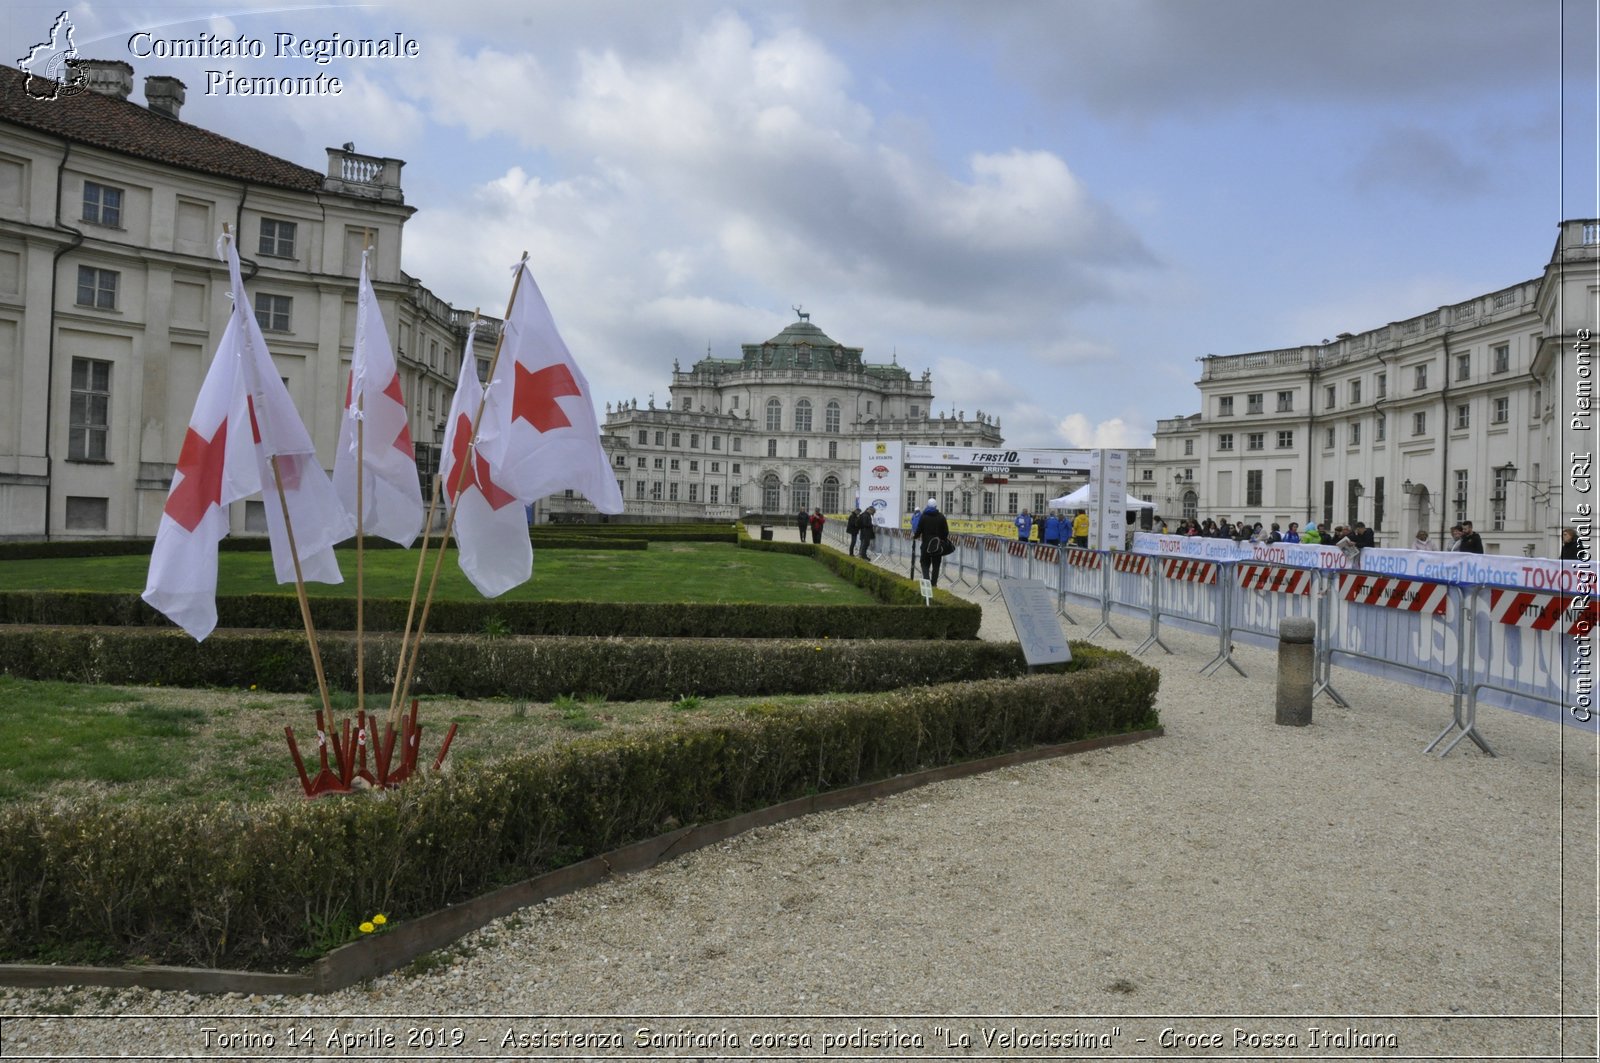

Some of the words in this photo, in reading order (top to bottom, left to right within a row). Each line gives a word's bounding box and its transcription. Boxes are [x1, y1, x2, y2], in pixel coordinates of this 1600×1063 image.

[1160, 539, 1180, 553] TOYOTA
[1206, 543, 1228, 558] Central
[1254, 547, 1285, 565] TOYOTA
[1287, 550, 1319, 568] HYBRID
[1364, 555, 1408, 575] HYBRID
[1417, 559, 1463, 582] Central
[1467, 563, 1518, 586] Motors
